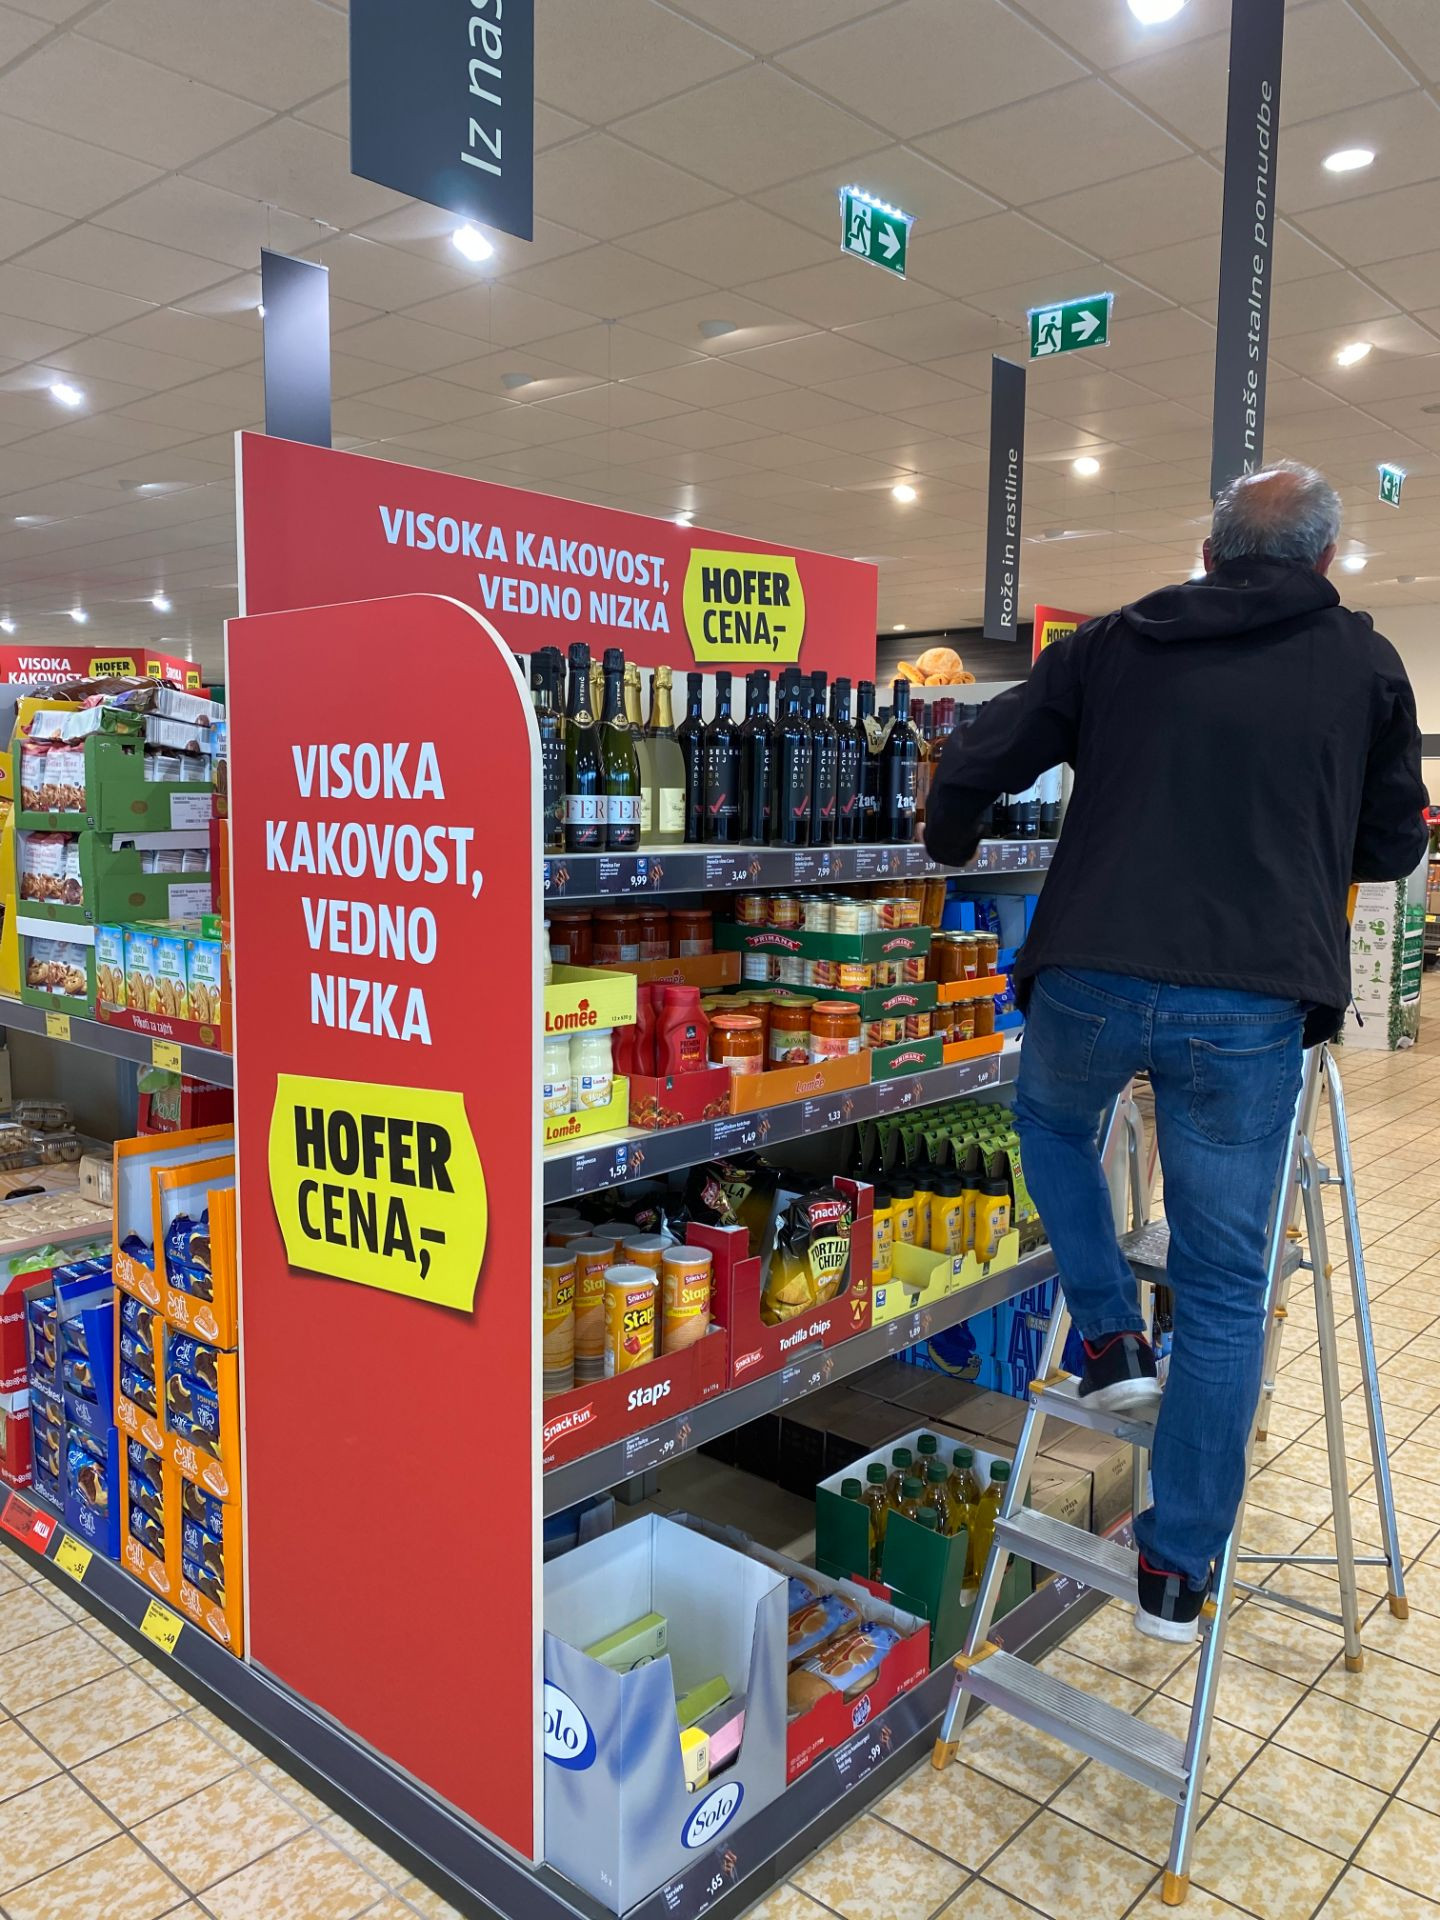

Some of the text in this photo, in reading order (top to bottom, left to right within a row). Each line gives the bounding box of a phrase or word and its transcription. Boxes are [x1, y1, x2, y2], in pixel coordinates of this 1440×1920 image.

[461, 117, 502, 177] Iz
[1243, 80, 1273, 476] z naše stalne ponudbe
[1000, 448, 1018, 627] Rože in rastline
[379, 505, 671, 596] VISOKA KAKOVOST,
[701, 566, 791, 608] HOFER
[479, 574, 670, 634] VEDNO NIZKA
[703, 609, 786, 653] CENA,-
[1046, 628, 1076, 643] HOF
[18, 657, 71, 671] VISOKA
[95, 662, 130, 671] HOFER
[291, 742, 445, 800] VISOKA
[265, 820, 484, 900] KAKOVOST,
[876, 864, 888, 873] 4,99
[925, 862, 936, 871] 3,99
[978, 860, 988, 868] 5,99
[1018, 857, 1028, 866] 2,99
[630, 875, 647, 886] 9,99
[732, 871, 747, 881] 3,49
[818, 868, 830, 878] 7,99
[301, 896, 437, 965] VEDNO
[753, 935, 794, 948] PRIMANA
[886, 939, 911, 949] PRIMANA
[310, 972, 433, 1046] NIZKA
[888, 995, 914, 1007] PRIMANA
[978, 1072, 988, 1083] 1,69
[900, 1093, 912, 1103] -,89
[828, 1110, 841, 1122] 1,33
[742, 1132, 756, 1144] 1,49
[294, 1105, 455, 1194] HOFER
[609, 1164, 627, 1179] 1,59
[297, 1179, 446, 1281] CENA,-
[116, 1253, 134, 1271] Soft
[116, 1264, 136, 1285] Cake
[168, 1290, 187, 1309] Soft
[627, 1292, 646, 1304] Snack
[167, 1303, 190, 1324] Cake
[780, 1320, 832, 1352] Tortilla Chips
[909, 1326, 921, 1338] 1,89
[736, 1352, 761, 1371] Snack Fun
[808, 1372, 820, 1386] -,95
[627, 1379, 672, 1412] Staps
[118, 1398, 136, 1418] Soft
[118, 1409, 138, 1430] Cake
[544, 1410, 590, 1442] Snack Fun
[174, 1439, 196, 1460] Soft
[659, 1440, 675, 1456] -,99
[174, 1454, 198, 1475] Cake
[126, 1536, 143, 1556] Soft
[180, 1580, 201, 1601] Soft
[543, 1708, 579, 1750] olo
[868, 1744, 881, 1762] -,99
[692, 1798, 733, 1838] Solo
[665, 1882, 684, 1899] Serviete
[706, 1873, 724, 1896] -,65
